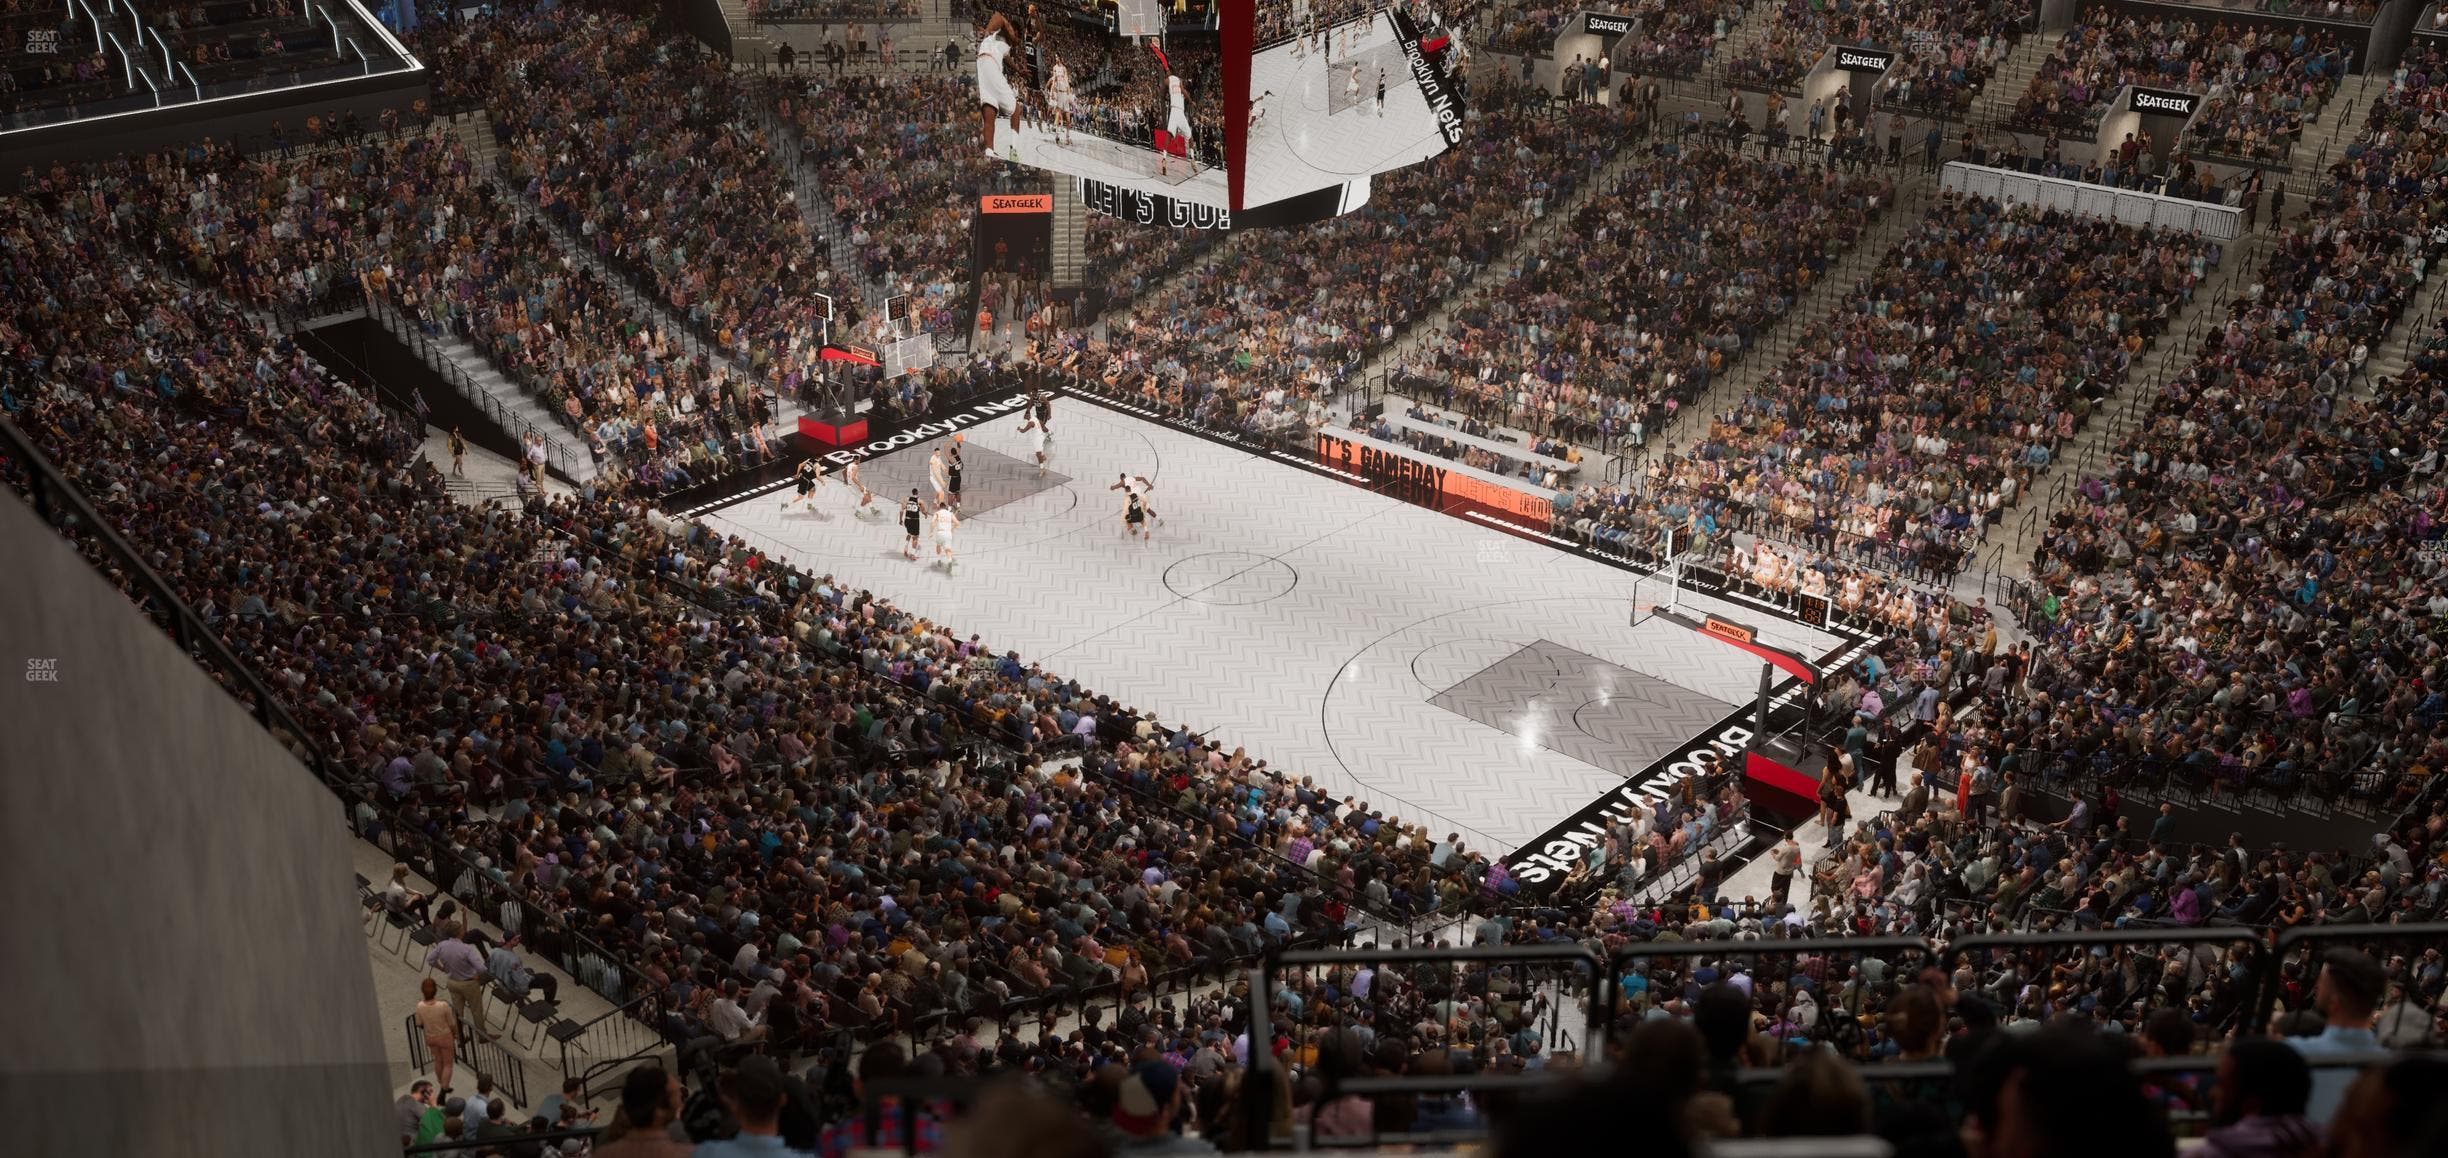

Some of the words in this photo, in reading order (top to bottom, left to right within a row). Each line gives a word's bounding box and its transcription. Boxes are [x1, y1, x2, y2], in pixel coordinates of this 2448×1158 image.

[1589, 17, 1629, 33] SEATGEEK
[1840, 52, 1887, 70] SEATGEEK
[1404, 40, 1440, 96] Brooklyn
[1432, 93, 1464, 144] Nets
[2136, 93, 2191, 113] SEATGEEK
[992, 198, 1043, 209] SEATGEEK
[824, 413, 980, 465] Brooklyn
[1317, 432, 1352, 462] IT'S
[1360, 445, 1447, 491] GAMEDAY
